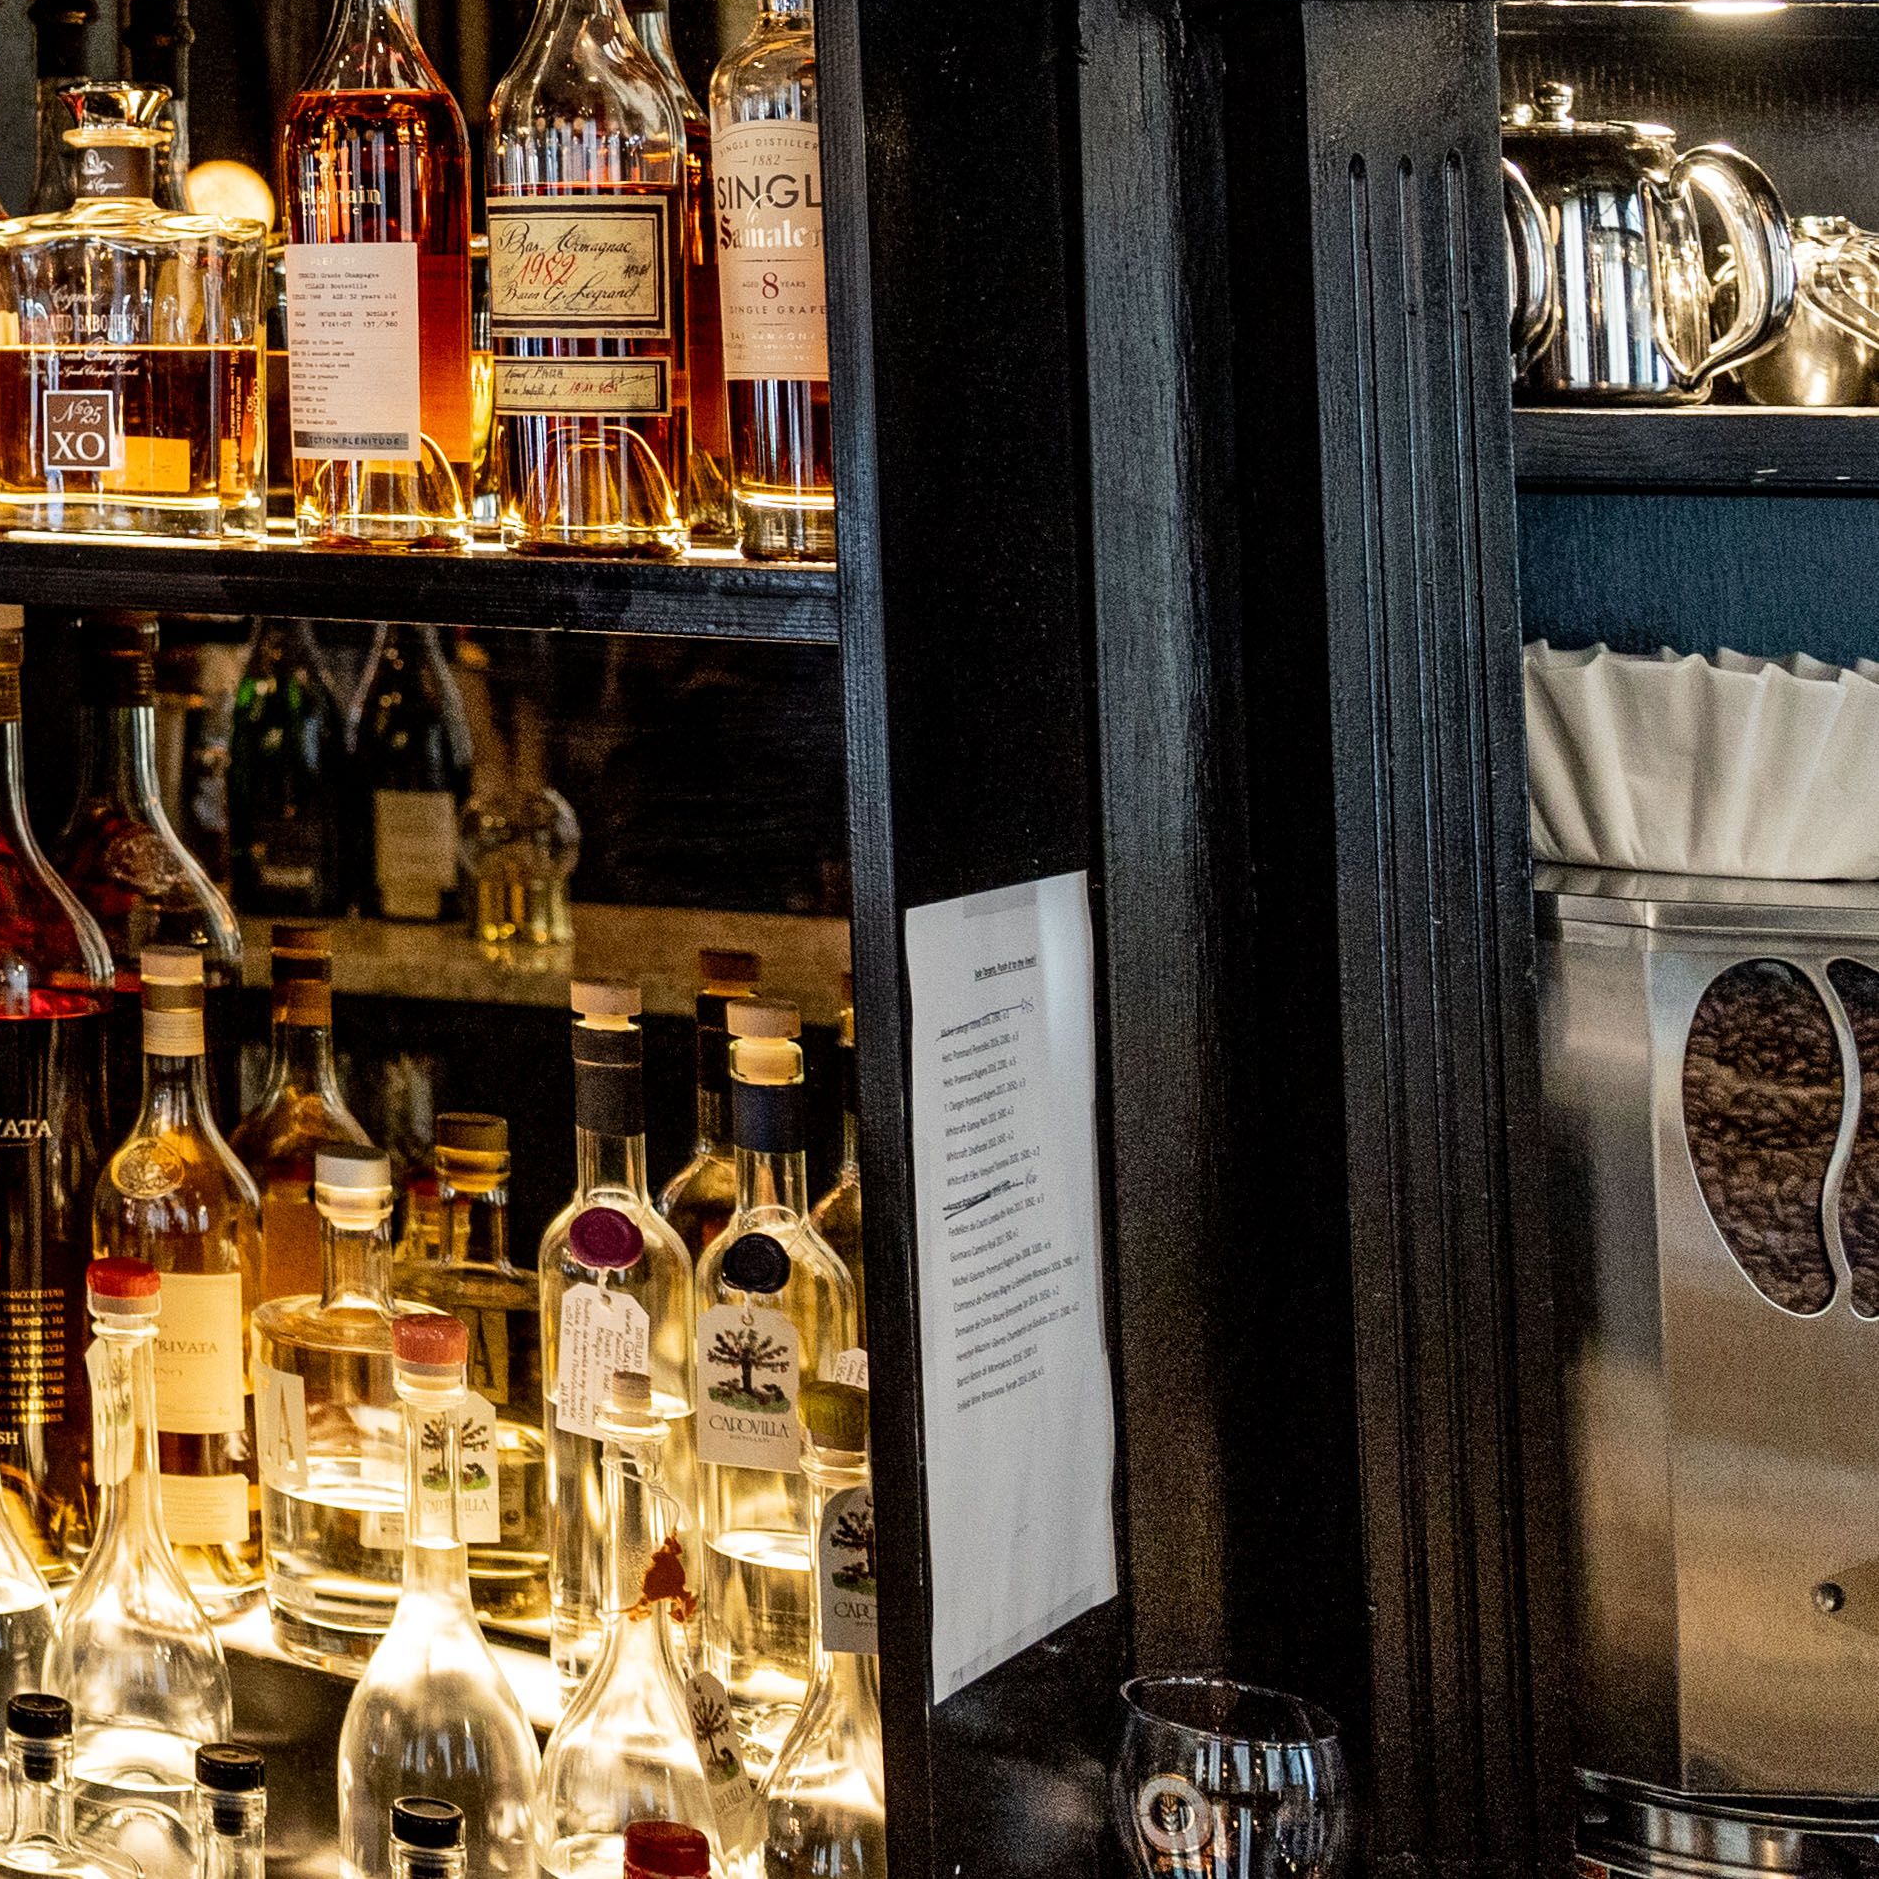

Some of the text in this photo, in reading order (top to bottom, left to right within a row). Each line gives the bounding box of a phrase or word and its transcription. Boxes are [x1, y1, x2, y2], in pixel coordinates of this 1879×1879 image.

[755, 137, 819, 153] DISTILLER
[752, 153, 781, 167] 1882
[717, 173, 823, 210] SINGL
[345, 272, 380, 280] Champagne
[516, 251, 578, 287] 1982
[500, 279, 540, 305] Baron
[566, 270, 640, 305] Legrand
[762, 271, 780, 300] 8
[781, 281, 807, 289] YEARS
[384, 293, 397, 301] old
[730, 305, 769, 315] SINGLE
[52, 431, 106, 461] XO
[342, 435, 401, 446] PLENITUDE
[708, 1414, 790, 1439] CAPOVILLA
